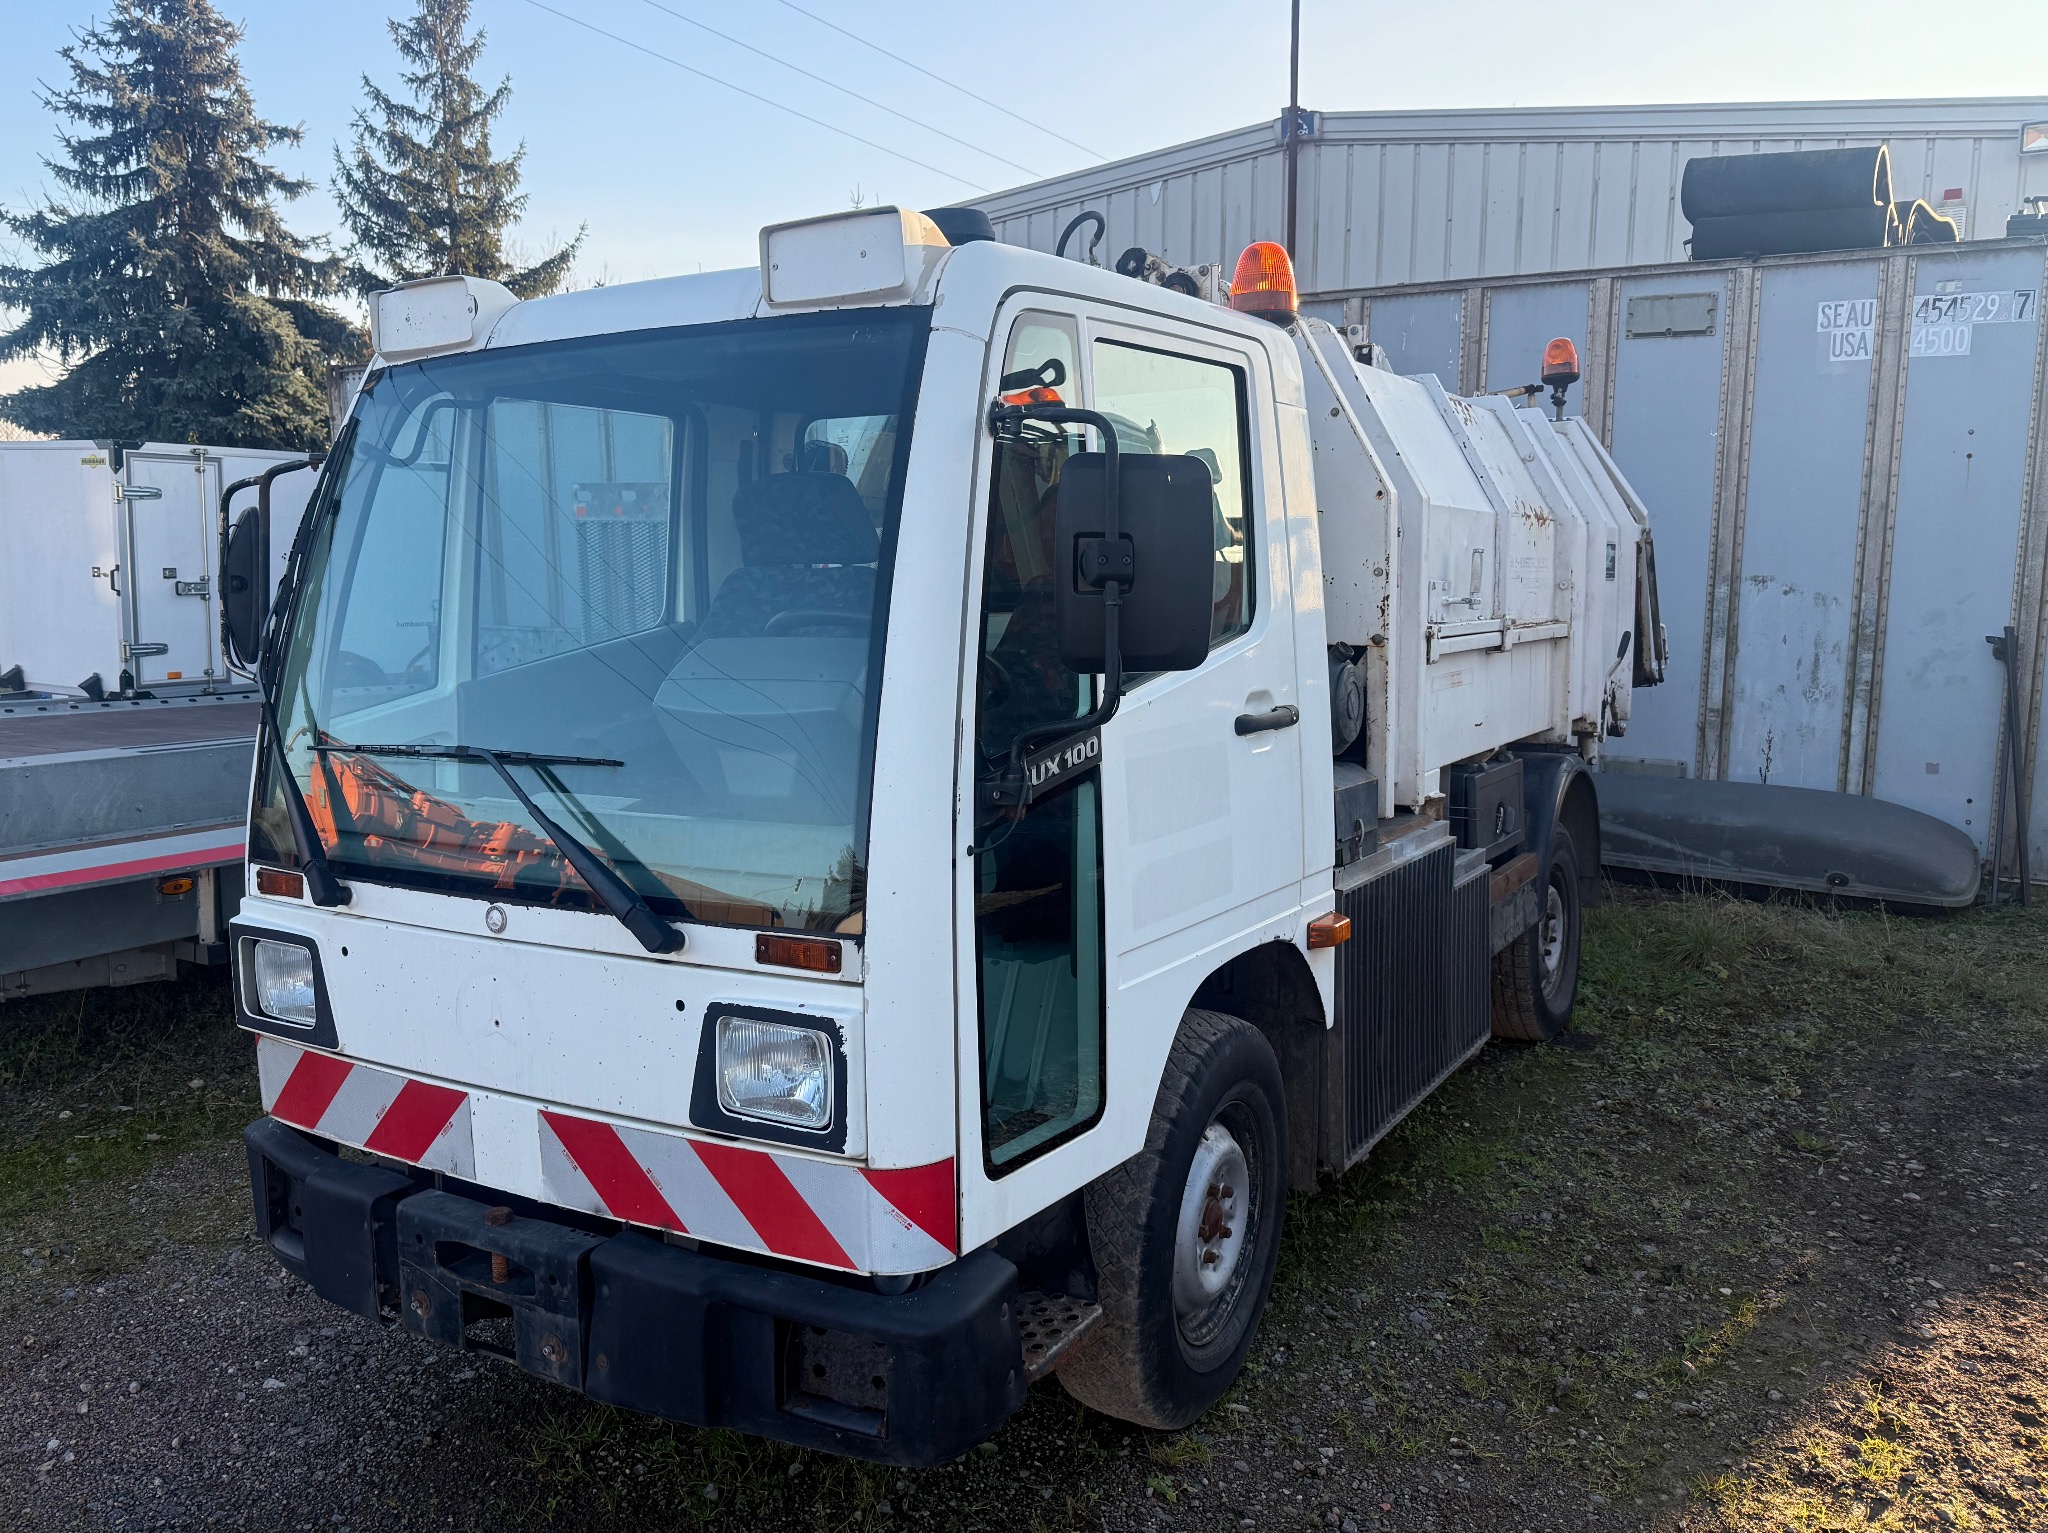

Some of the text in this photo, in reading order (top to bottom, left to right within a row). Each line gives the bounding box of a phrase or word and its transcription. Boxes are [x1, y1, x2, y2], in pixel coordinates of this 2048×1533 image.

[1820, 293, 2031, 329] SEAU 454529 7
[1832, 326, 1969, 357] USA 4500
[1030, 736, 1099, 786] UX 100
